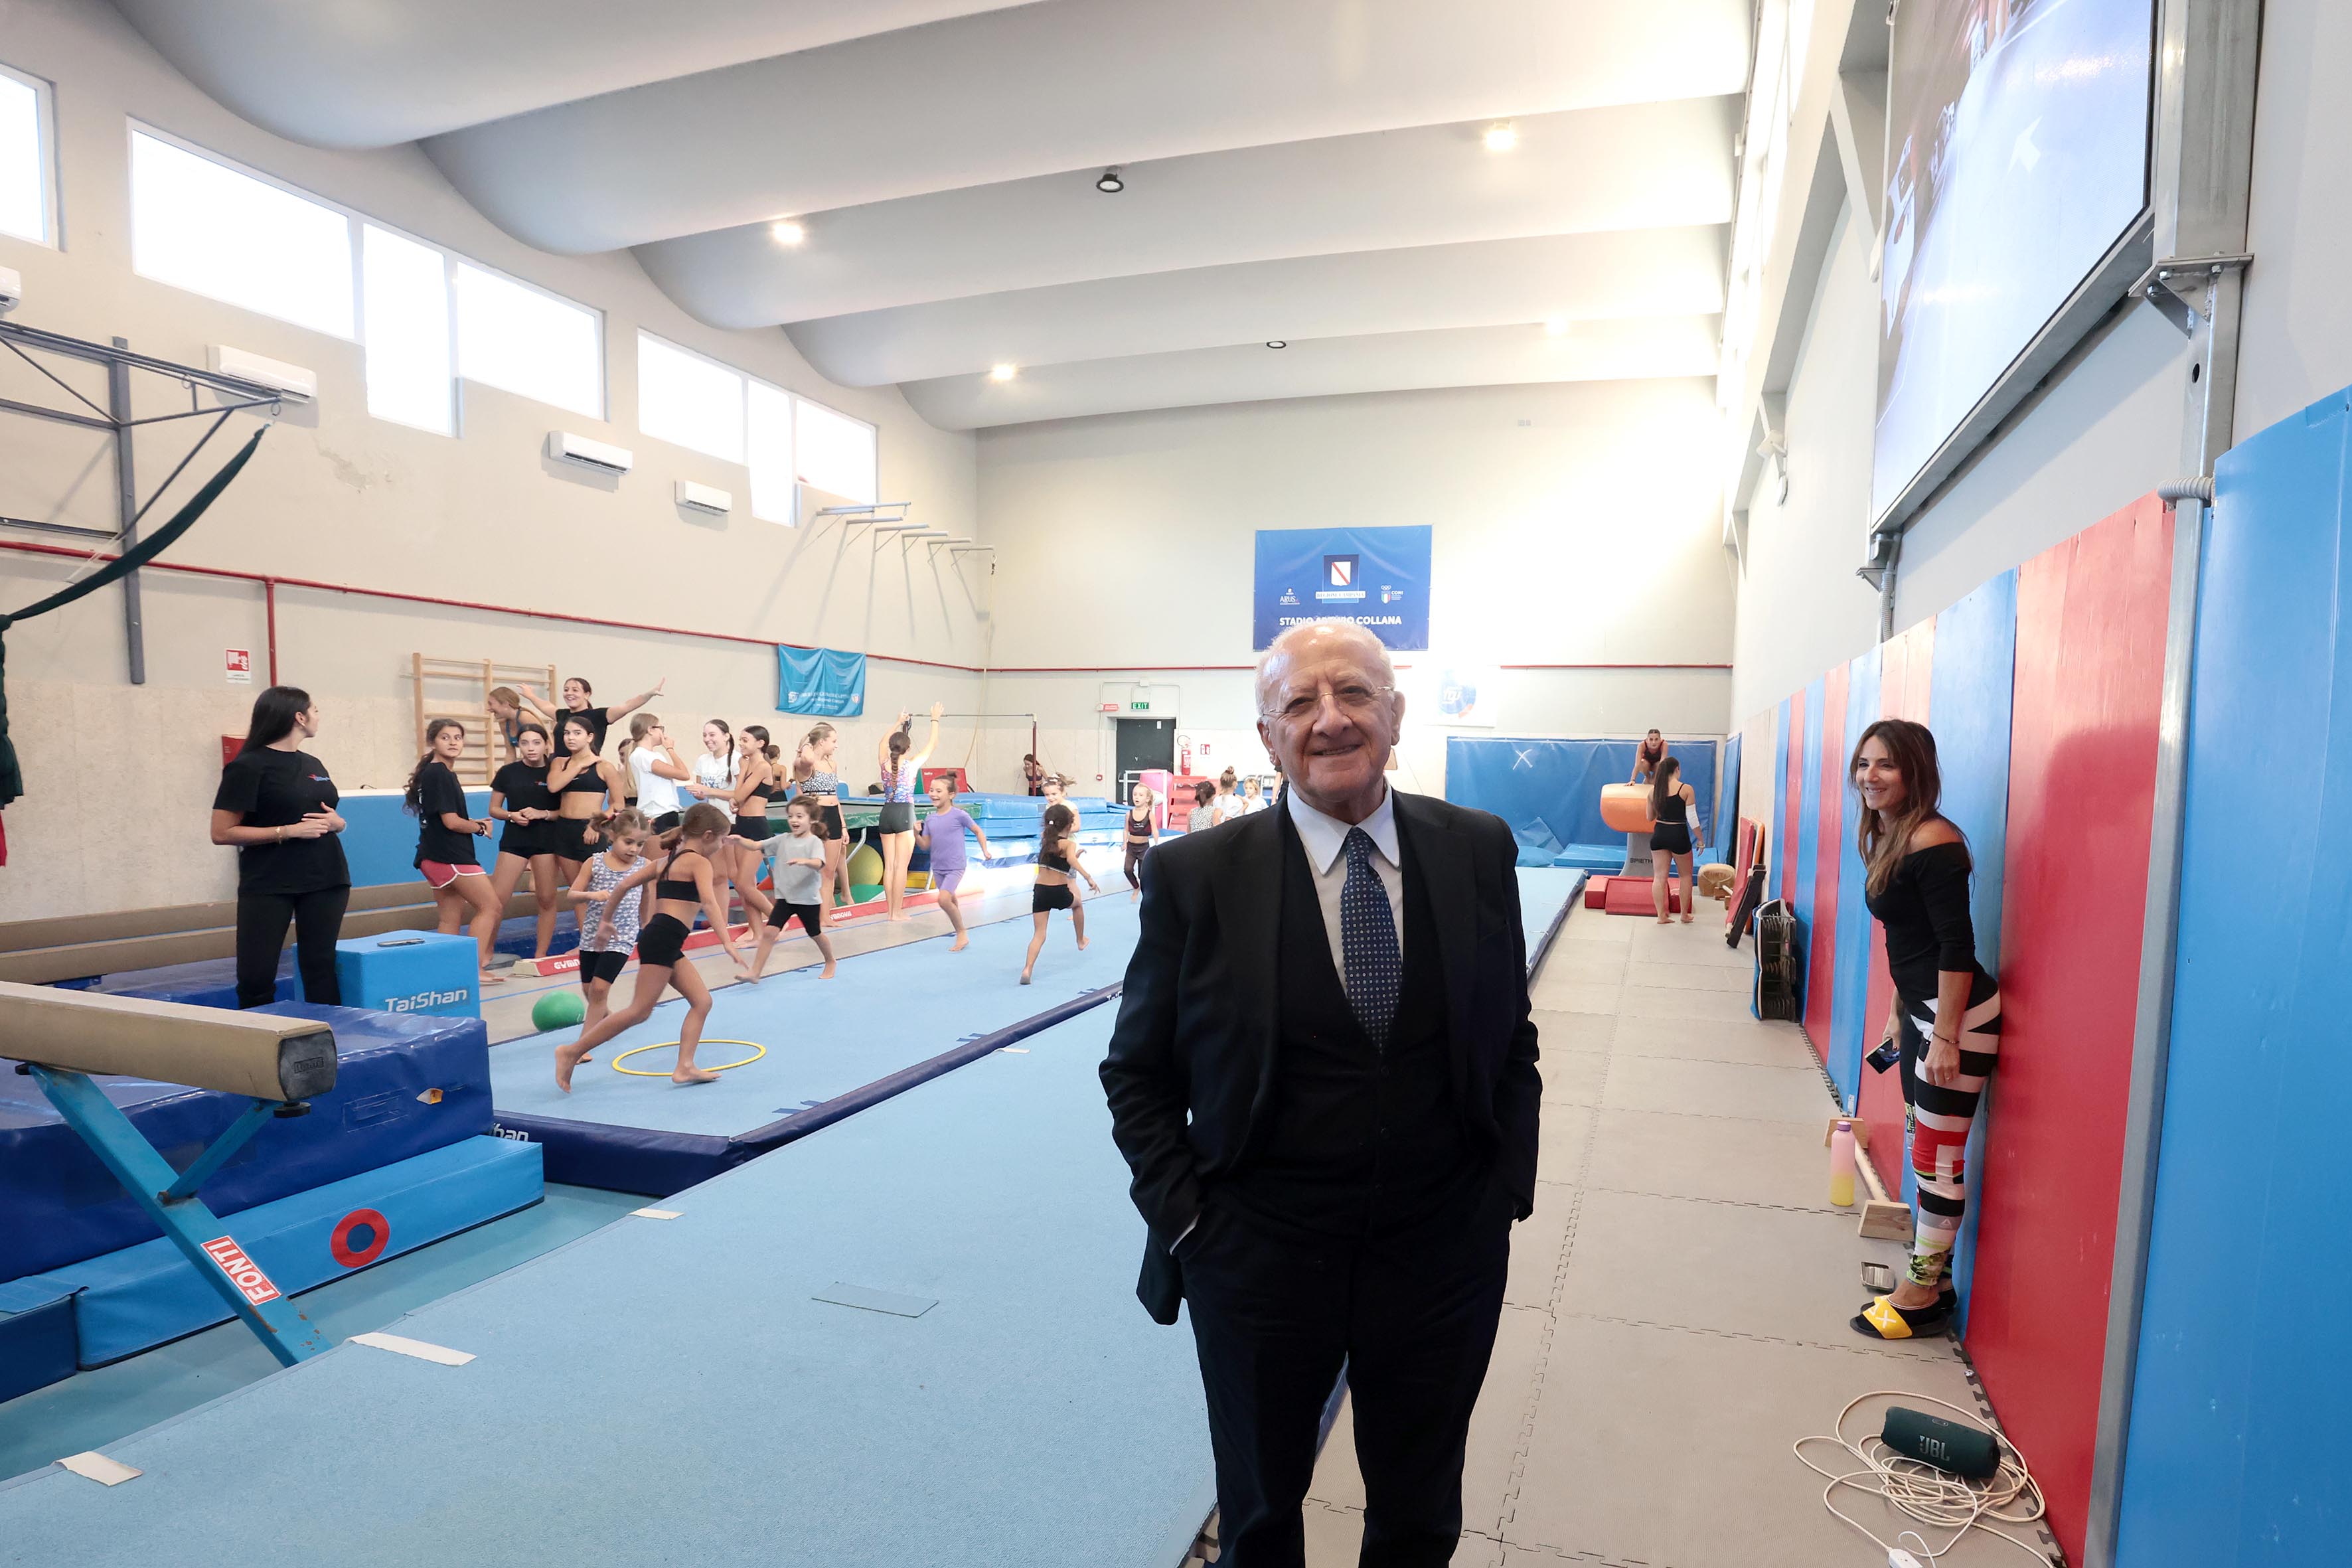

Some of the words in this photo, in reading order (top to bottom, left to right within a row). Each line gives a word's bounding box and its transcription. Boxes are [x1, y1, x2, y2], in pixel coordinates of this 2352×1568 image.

[1279, 617, 1313, 625] STADIO
[1356, 615, 1402, 625] COLLANA
[830, 910, 852, 920] YMNOVA
[554, 959, 581, 970] GYMN
[384, 988, 467, 1012] TaiShan
[493, 1123, 529, 1142] han
[206, 1240, 275, 1300] FONTI
[1919, 1435, 1950, 1462] JBL
